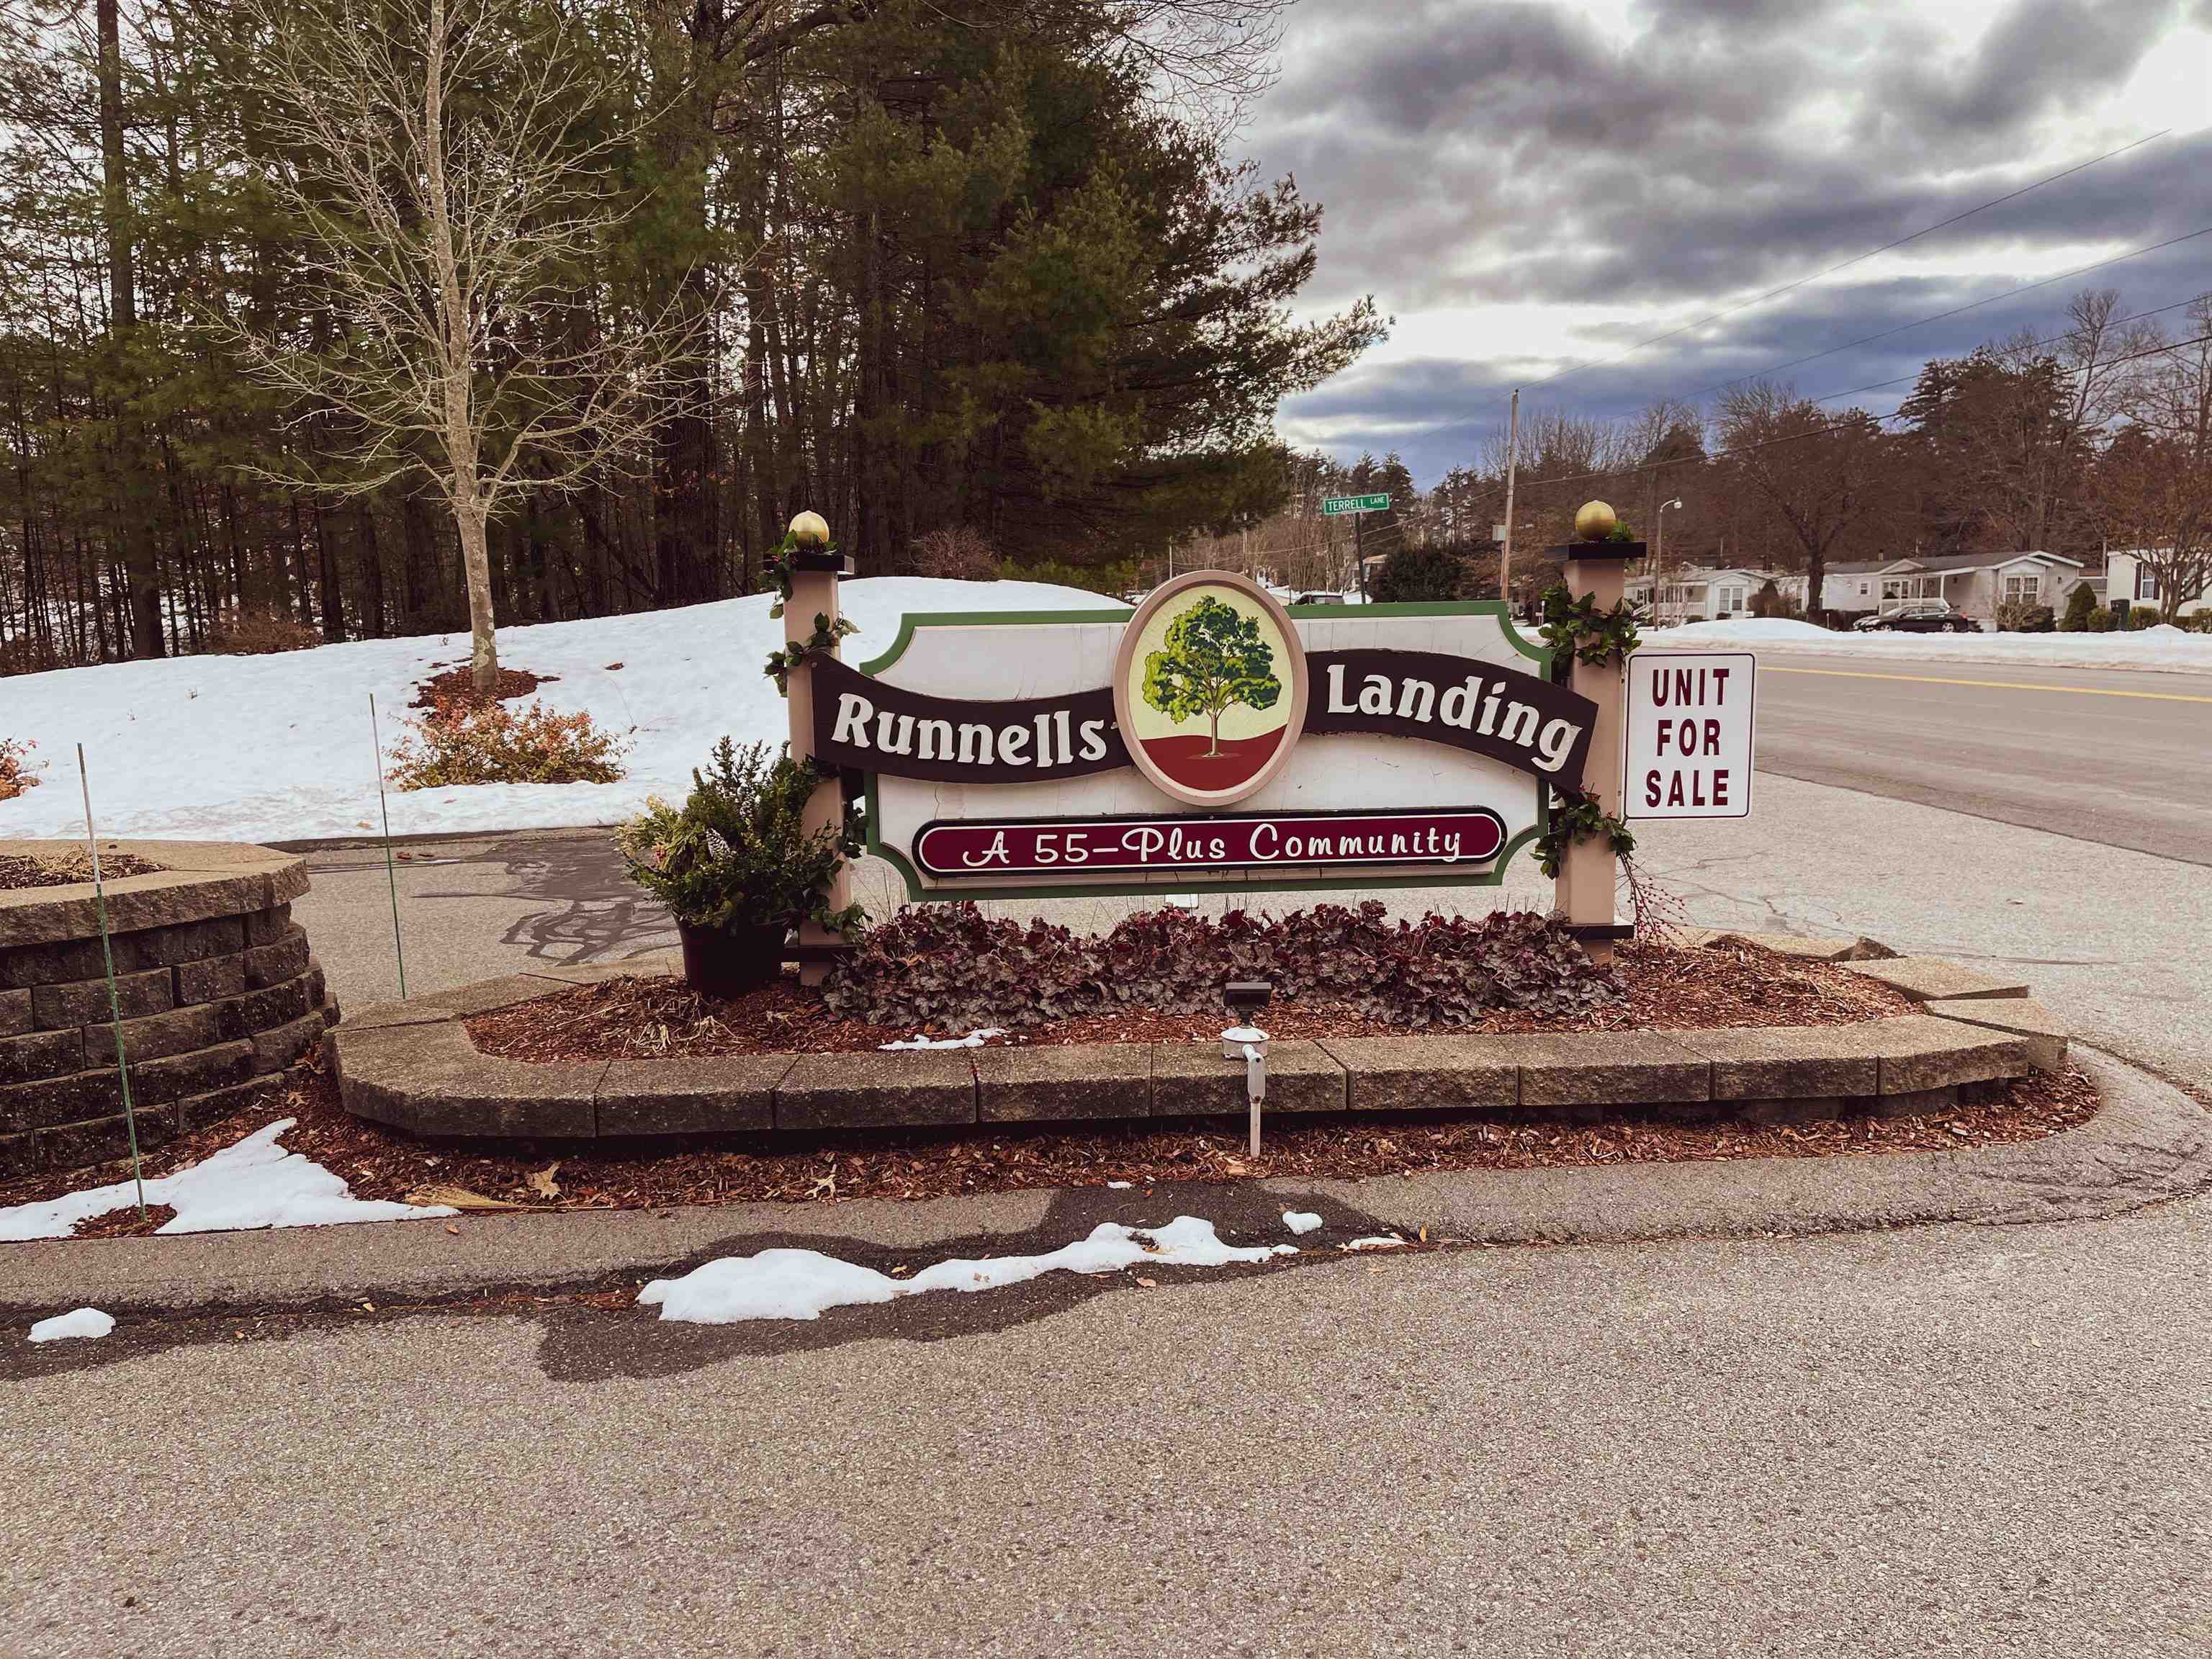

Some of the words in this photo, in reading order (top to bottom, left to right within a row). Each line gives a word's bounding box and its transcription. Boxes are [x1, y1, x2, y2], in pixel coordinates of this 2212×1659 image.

[1327, 498, 1366, 511] TERRELL
[1652, 667, 1730, 707] UNIT
[1326, 664, 1583, 772] Landing
[1657, 718, 1721, 757] FOR
[1645, 769, 1730, 808] SALE
[962, 831, 1010, 867] A
[1034, 827, 1226, 863] 55-Plus
[1249, 823, 1462, 863] Community
